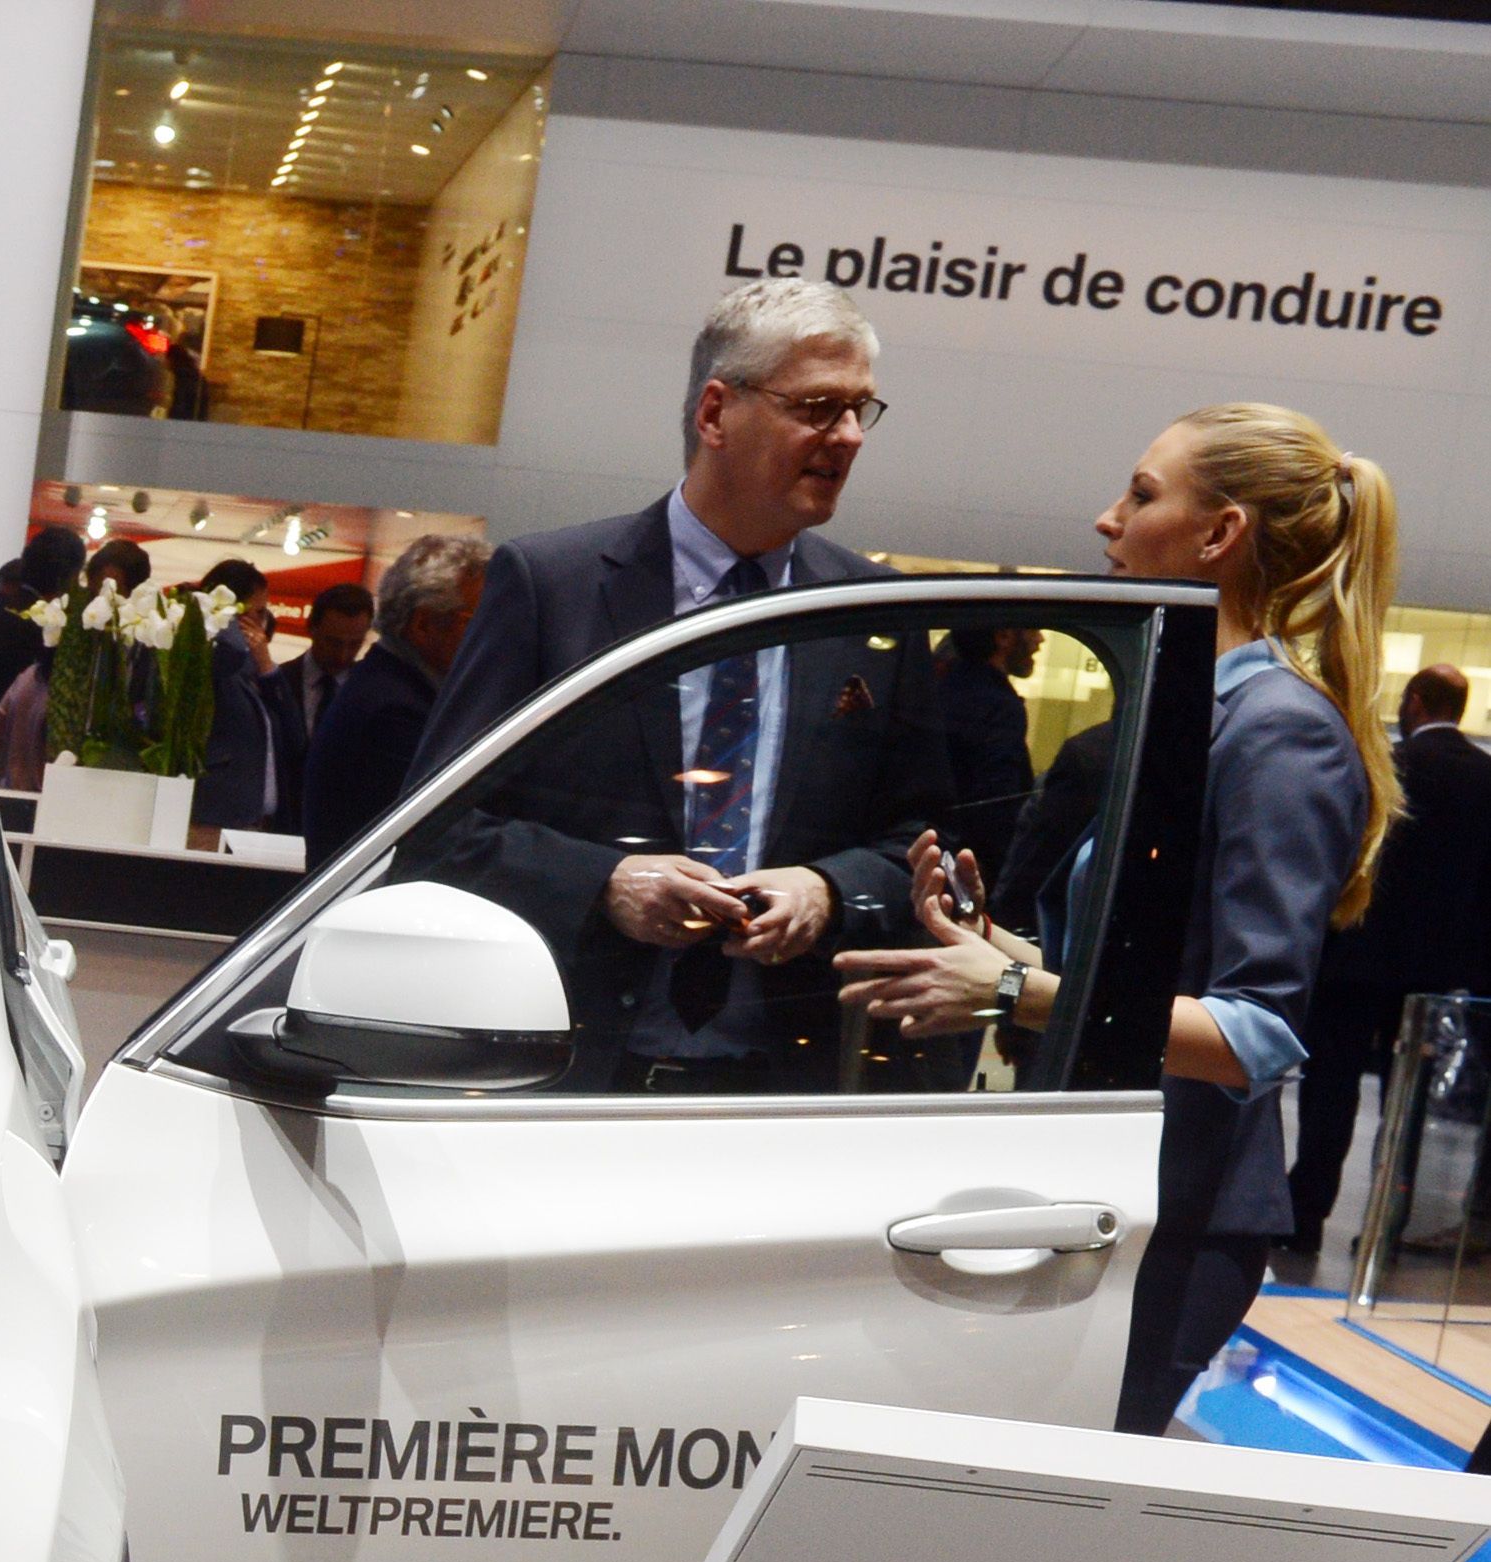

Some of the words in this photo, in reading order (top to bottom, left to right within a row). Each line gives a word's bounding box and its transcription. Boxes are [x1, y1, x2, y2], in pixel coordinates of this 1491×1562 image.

[724, 223, 805, 280] Le
[824, 236, 1027, 301] plaisir
[1042, 252, 1125, 311] de
[1145, 271, 1443, 337] conduire
[217, 1406, 597, 1486] PREMIÈRE
[241, 1493, 622, 1541] WELTPREMIERE.
